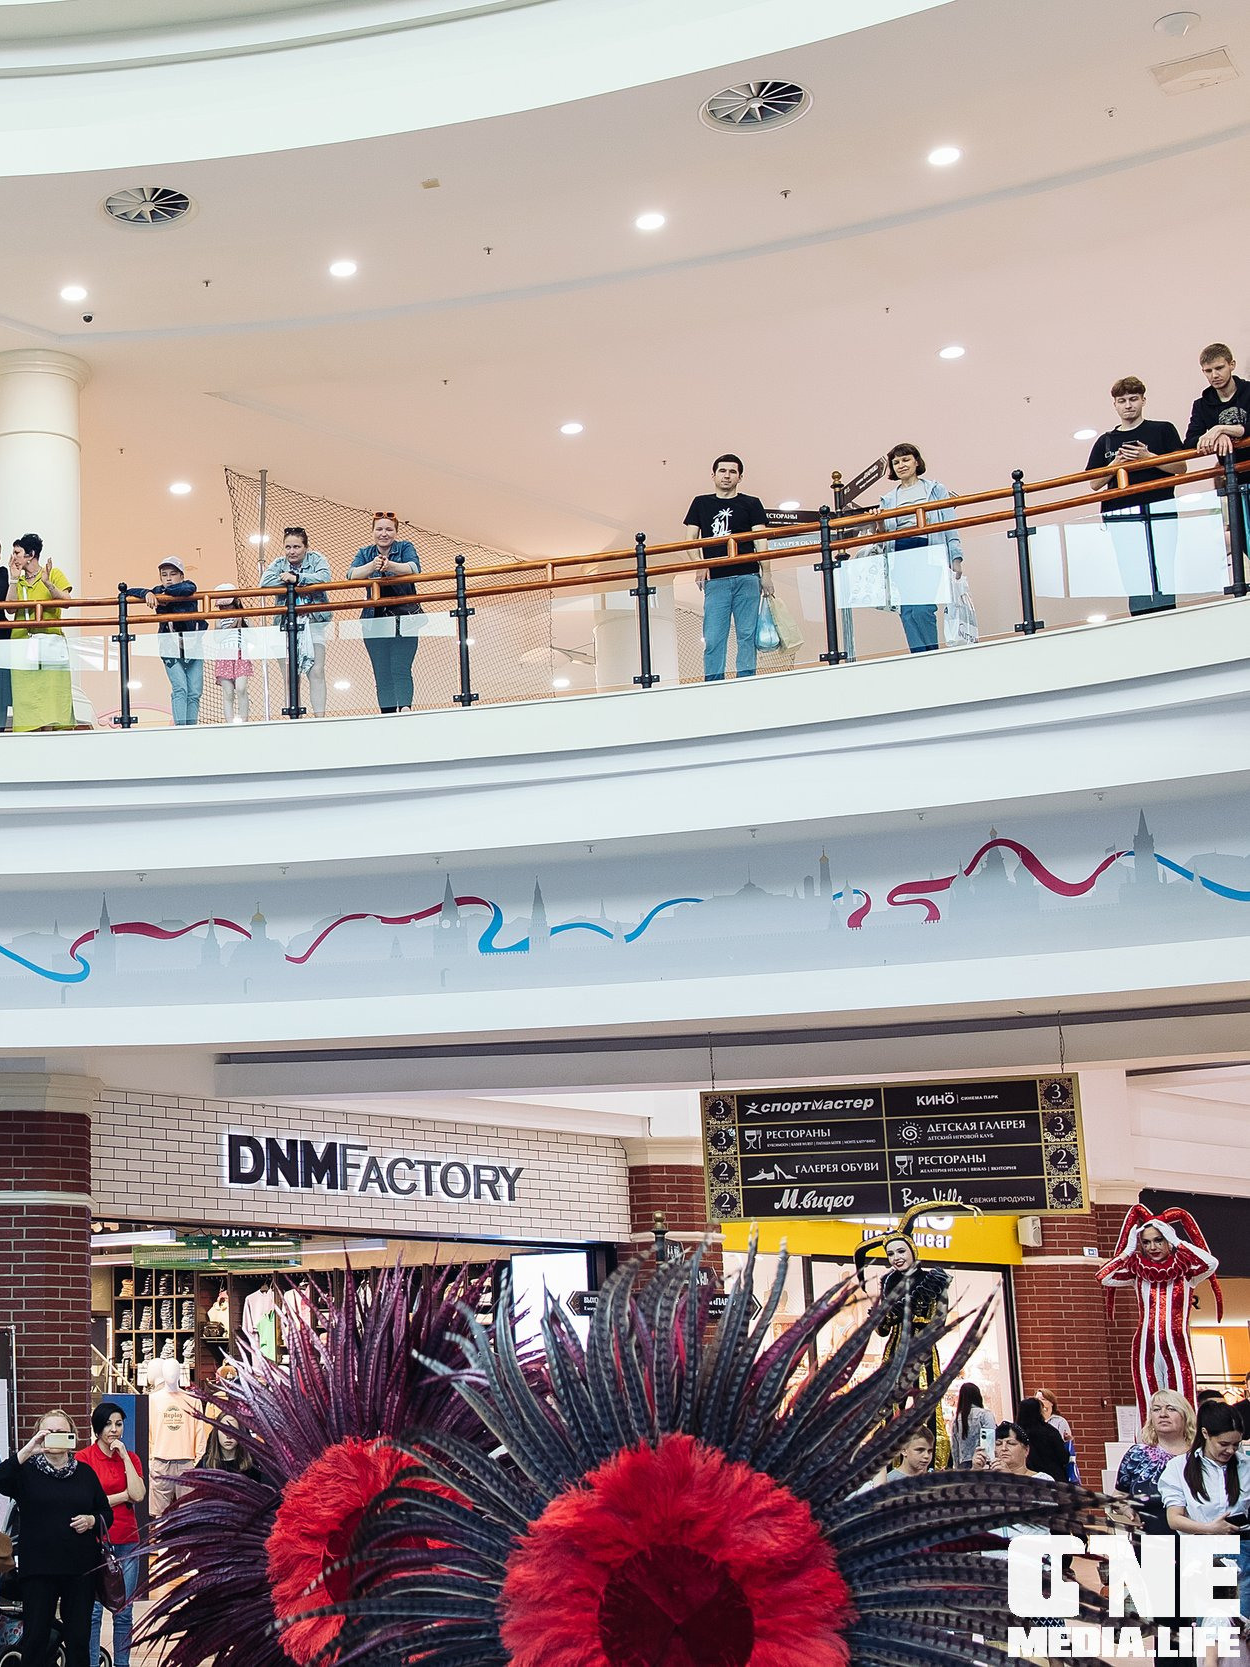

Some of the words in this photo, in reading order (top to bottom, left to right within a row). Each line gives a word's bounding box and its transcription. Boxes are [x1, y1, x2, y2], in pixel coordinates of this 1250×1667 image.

[1051, 1084, 1061, 1099] 3
[927, 1121, 977, 1133] ДЕТСКАЯ
[979, 1120, 1026, 1130] ГАЛЕРЕЯ
[1054, 1116, 1064, 1131] 3
[766, 1128, 831, 1139] РЕСТОРАНЫ
[918, 1154, 986, 1165] РЕСТОРАНЫ
[1057, 1149, 1067, 1164] 2
[719, 1162, 729, 1177] 2
[795, 1164, 838, 1174] ГАЛЕРЕЯ
[841, 1162, 879, 1172] ОБУВИ
[720, 1193, 731, 1208] 2
[969, 1196, 997, 1204] СВЕЖИЕ
[998, 1195, 1035, 1203] ПРОДУКТЫ
